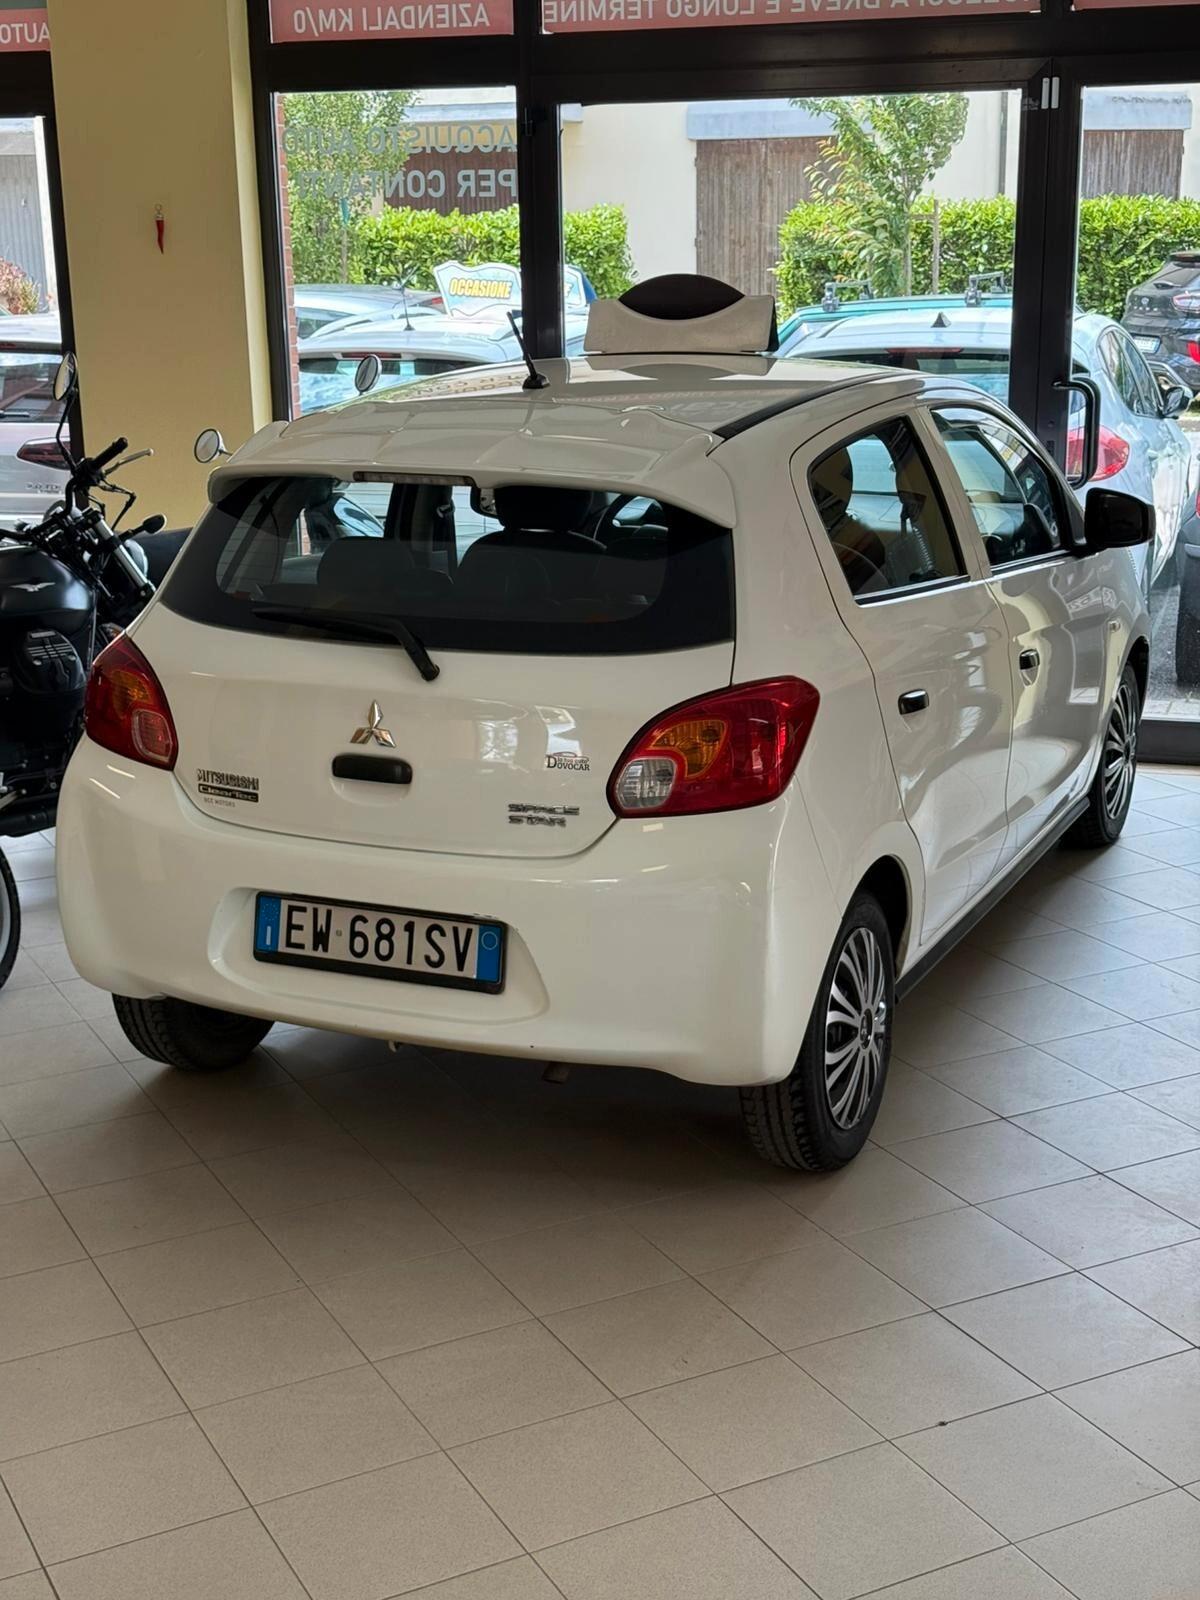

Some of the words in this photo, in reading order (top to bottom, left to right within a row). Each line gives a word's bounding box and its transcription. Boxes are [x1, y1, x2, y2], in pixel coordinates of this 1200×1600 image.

[450, 278, 513, 299] OCCASIONE
[546, 754, 590, 771] DOVOCAR
[197, 768, 259, 791] MITSUBISHI
[200, 785, 258, 802] ClearTec
[285, 904, 332, 953] EW
[350, 914, 474, 972] 681SV
